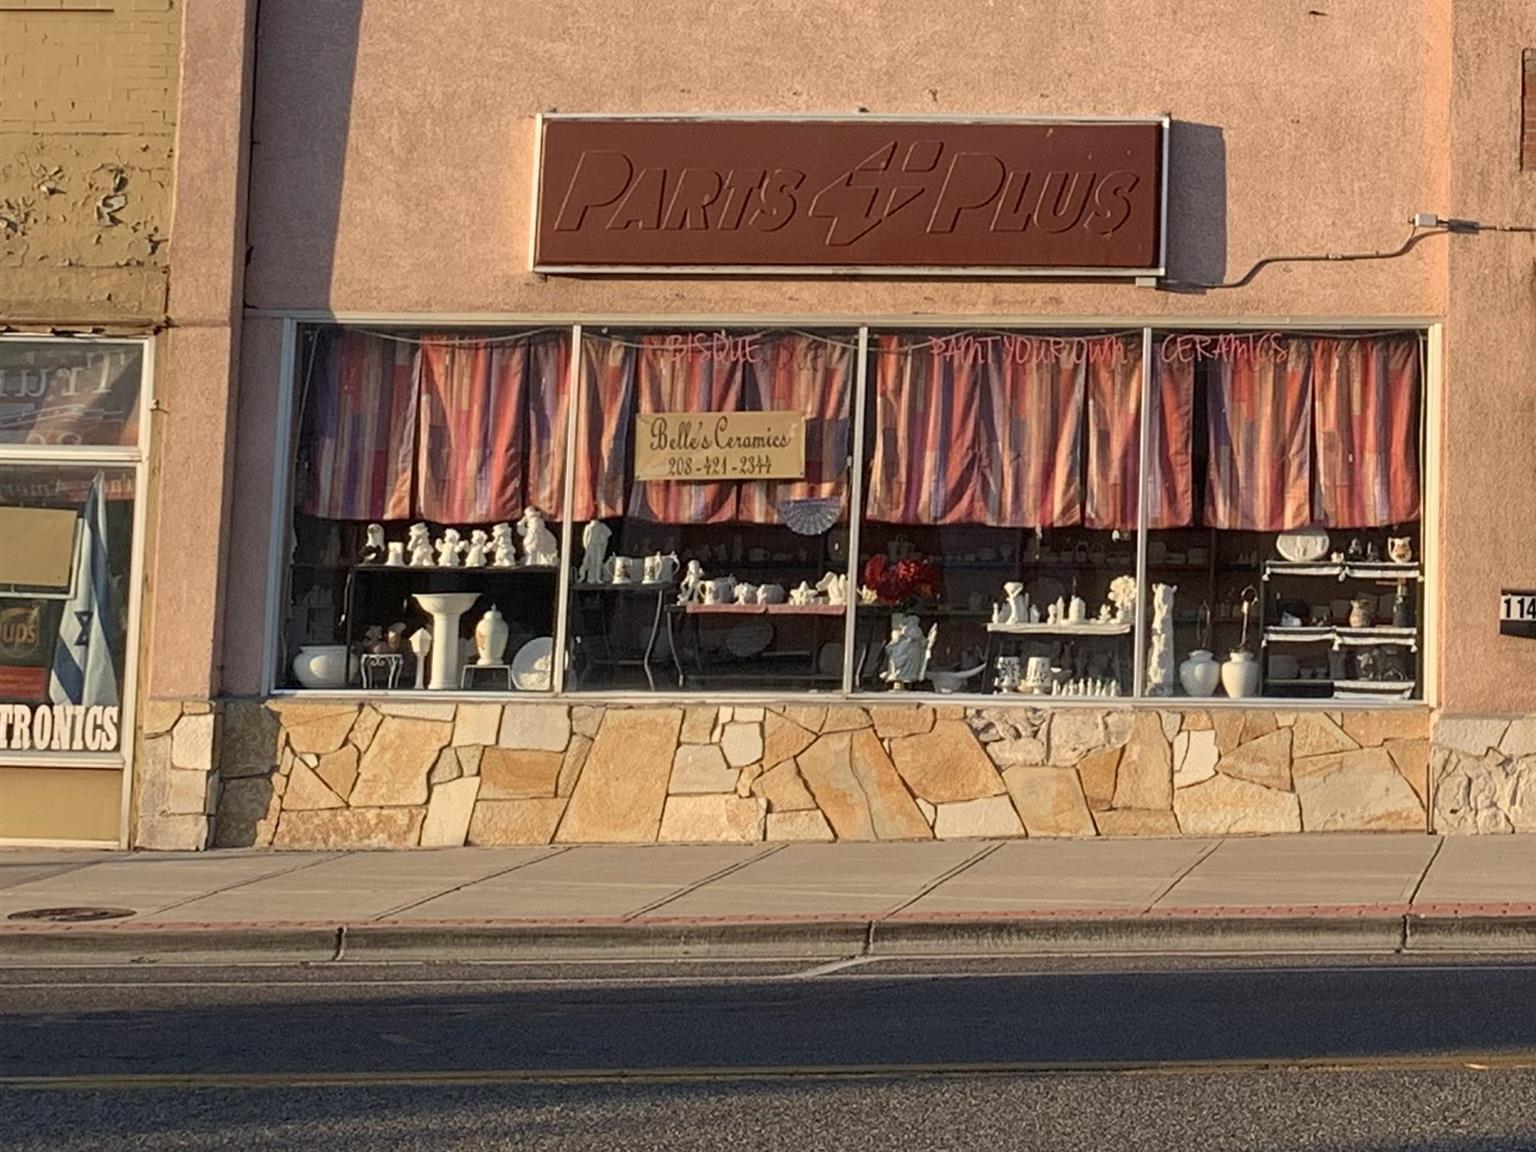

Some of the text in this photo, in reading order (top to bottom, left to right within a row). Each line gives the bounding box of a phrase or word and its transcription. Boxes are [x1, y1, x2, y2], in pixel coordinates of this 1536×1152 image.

[554, 150, 805, 232] PARTS
[927, 151, 1140, 236] PLUS
[666, 330, 763, 364] BISQUE
[1003, 334, 1065, 365] YOUR
[1160, 333, 1290, 365] CERAMICS
[650, 416, 792, 451] Belle's Ceramics
[1503, 597, 1536, 619] 114
